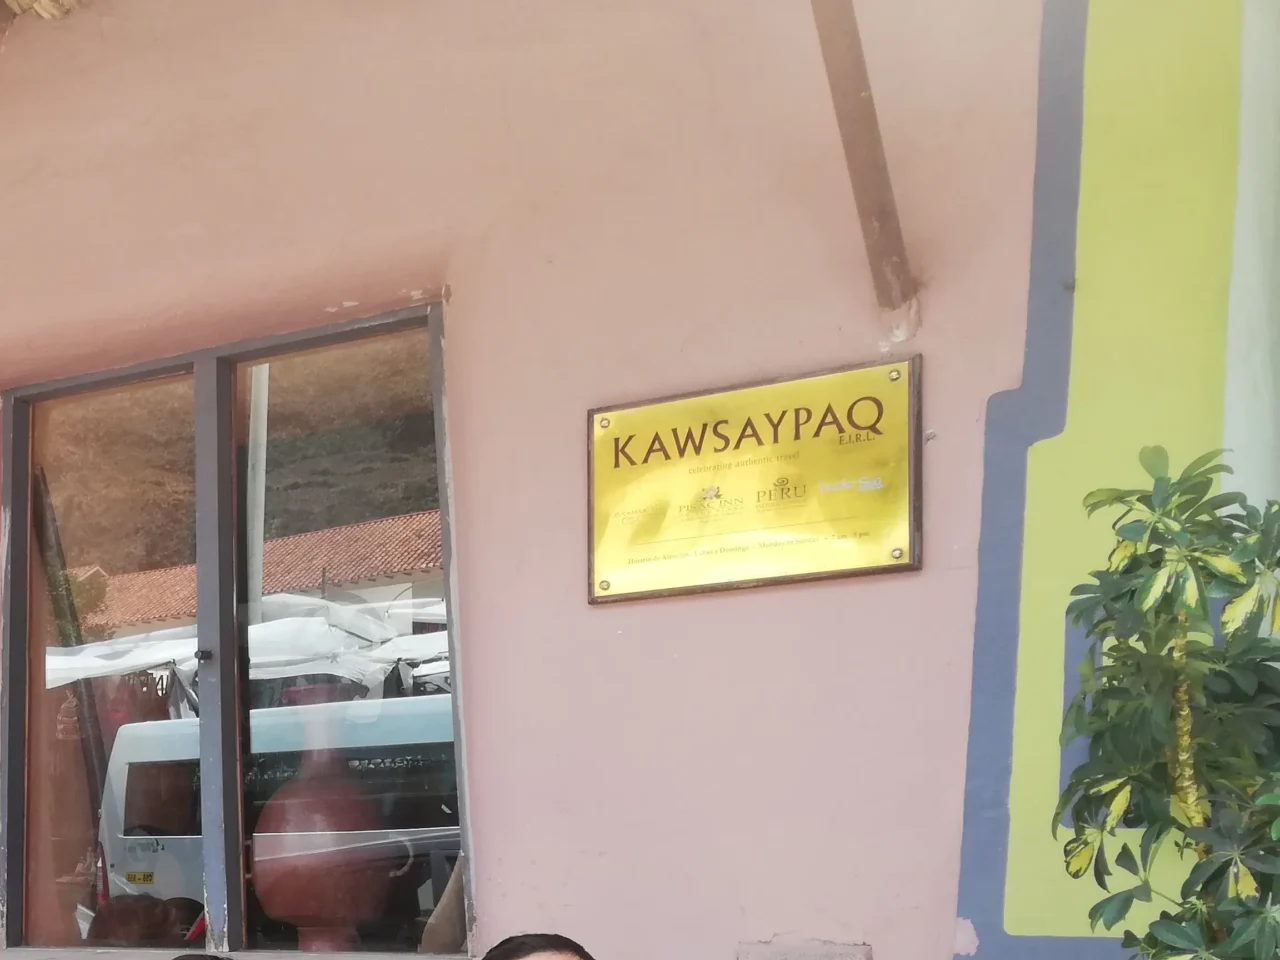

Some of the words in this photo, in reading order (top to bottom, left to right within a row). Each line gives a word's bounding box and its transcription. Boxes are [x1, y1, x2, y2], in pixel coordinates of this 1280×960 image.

[612, 395, 885, 469] KAWSAYPAQ
[838, 431, 876, 447] E.I.R.L.
[688, 461, 733, 475] celebrating
[734, 455, 773, 468] authentic
[776, 451, 801, 462] travel
[719, 497, 744, 508] INN
[756, 485, 807, 503] PERU
